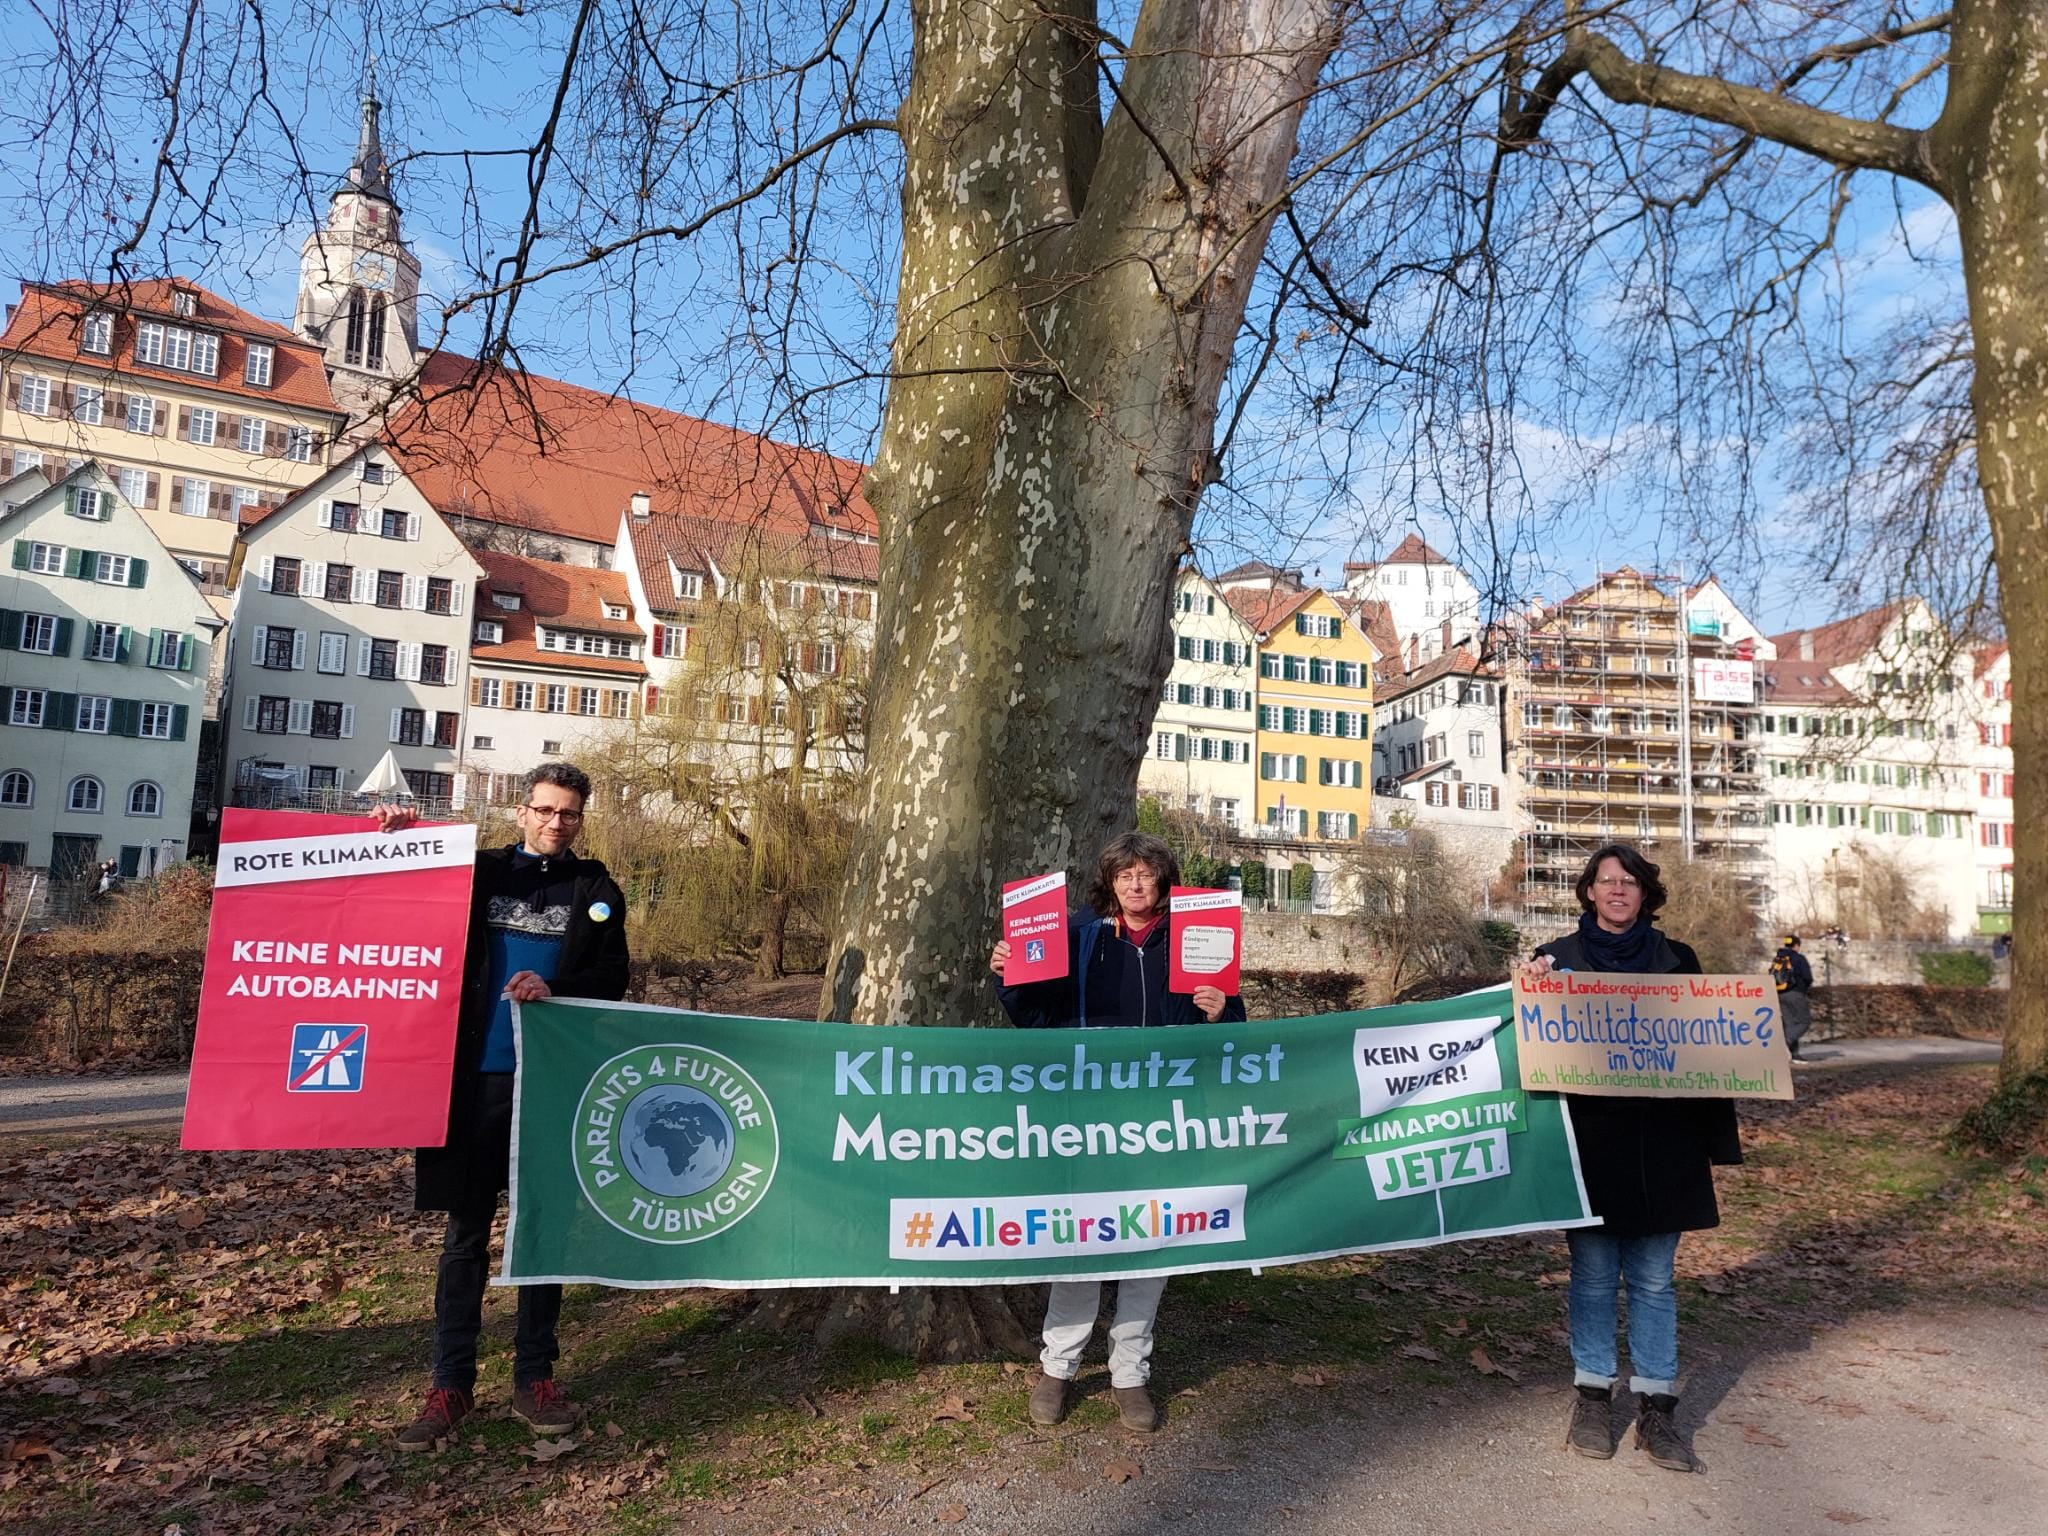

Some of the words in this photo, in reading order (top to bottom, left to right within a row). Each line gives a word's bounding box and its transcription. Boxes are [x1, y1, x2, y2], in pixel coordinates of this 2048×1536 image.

[234, 852, 293, 872] ROTE
[302, 839, 444, 866] KLIMAKARTE
[1006, 894, 1020, 903] ROTE
[1021, 879, 1056, 896] KLIMAKARTE
[1193, 898, 1232, 907] KLIMAKARTE
[1009, 916, 1031, 928] KEINE
[1034, 911, 1059, 923] NEUEN
[1010, 922, 1059, 938] AUTOBAHNEN
[231, 940, 329, 965] KEINE
[337, 943, 443, 968] NEUEN
[226, 973, 439, 1000] AUTOBAHNEN
[1520, 974, 1563, 994] Liebe
[1567, 975, 1684, 1002] Landesregierung:
[1689, 979, 1713, 998] Wo
[1714, 982, 1732, 998] ist
[1735, 981, 1764, 998] Eure
[1520, 1001, 1774, 1050] Mobilitätsgarantie?
[1364, 1045, 1420, 1067] KEIN
[1428, 1037, 1484, 1062] GRAD
[1607, 1050, 1628, 1071] im
[1632, 1046, 1676, 1073] ÖPNV
[834, 1043, 1197, 1096] Klimaschutz
[1220, 1042, 1285, 1085] ist
[1385, 1064, 1468, 1097] WEITER!
[1723, 1067, 1779, 1093] überall
[586, 1065, 642, 1189] PARENTS
[648, 1055, 666, 1077] 4
[674, 1055, 762, 1130] FUTURE
[832, 1099, 1288, 1162] Menschenschutz
[1343, 1101, 1518, 1146] KLIMAPOLITIK
[627, 1161, 763, 1233] TÜBINGEN
[904, 1199, 1231, 1249] #AlleFürsKlima
